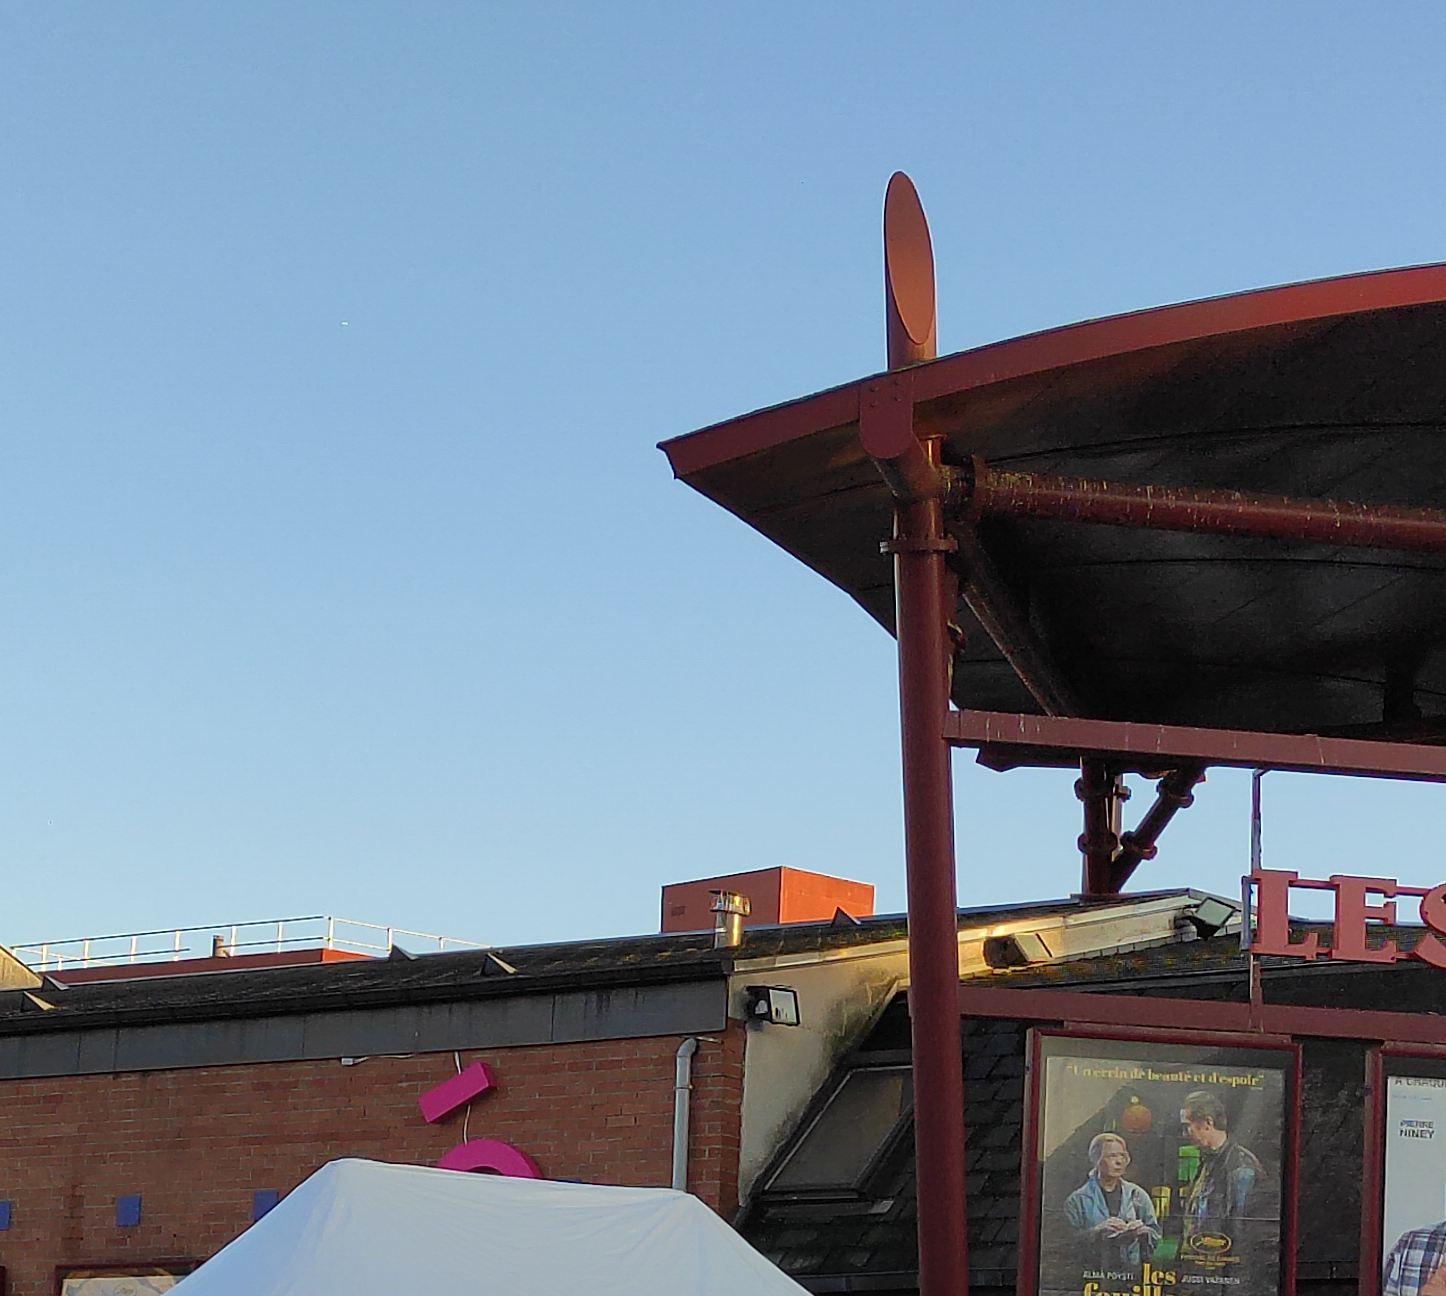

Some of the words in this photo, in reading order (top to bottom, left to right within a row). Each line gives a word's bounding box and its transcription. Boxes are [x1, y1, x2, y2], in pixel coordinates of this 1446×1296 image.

[1194, 1071, 1205, 1084] et
[1400, 1119, 1435, 1129] PIERRE
[1399, 1129, 1436, 1140] NINEY
[1142, 1263, 1177, 1286] les
